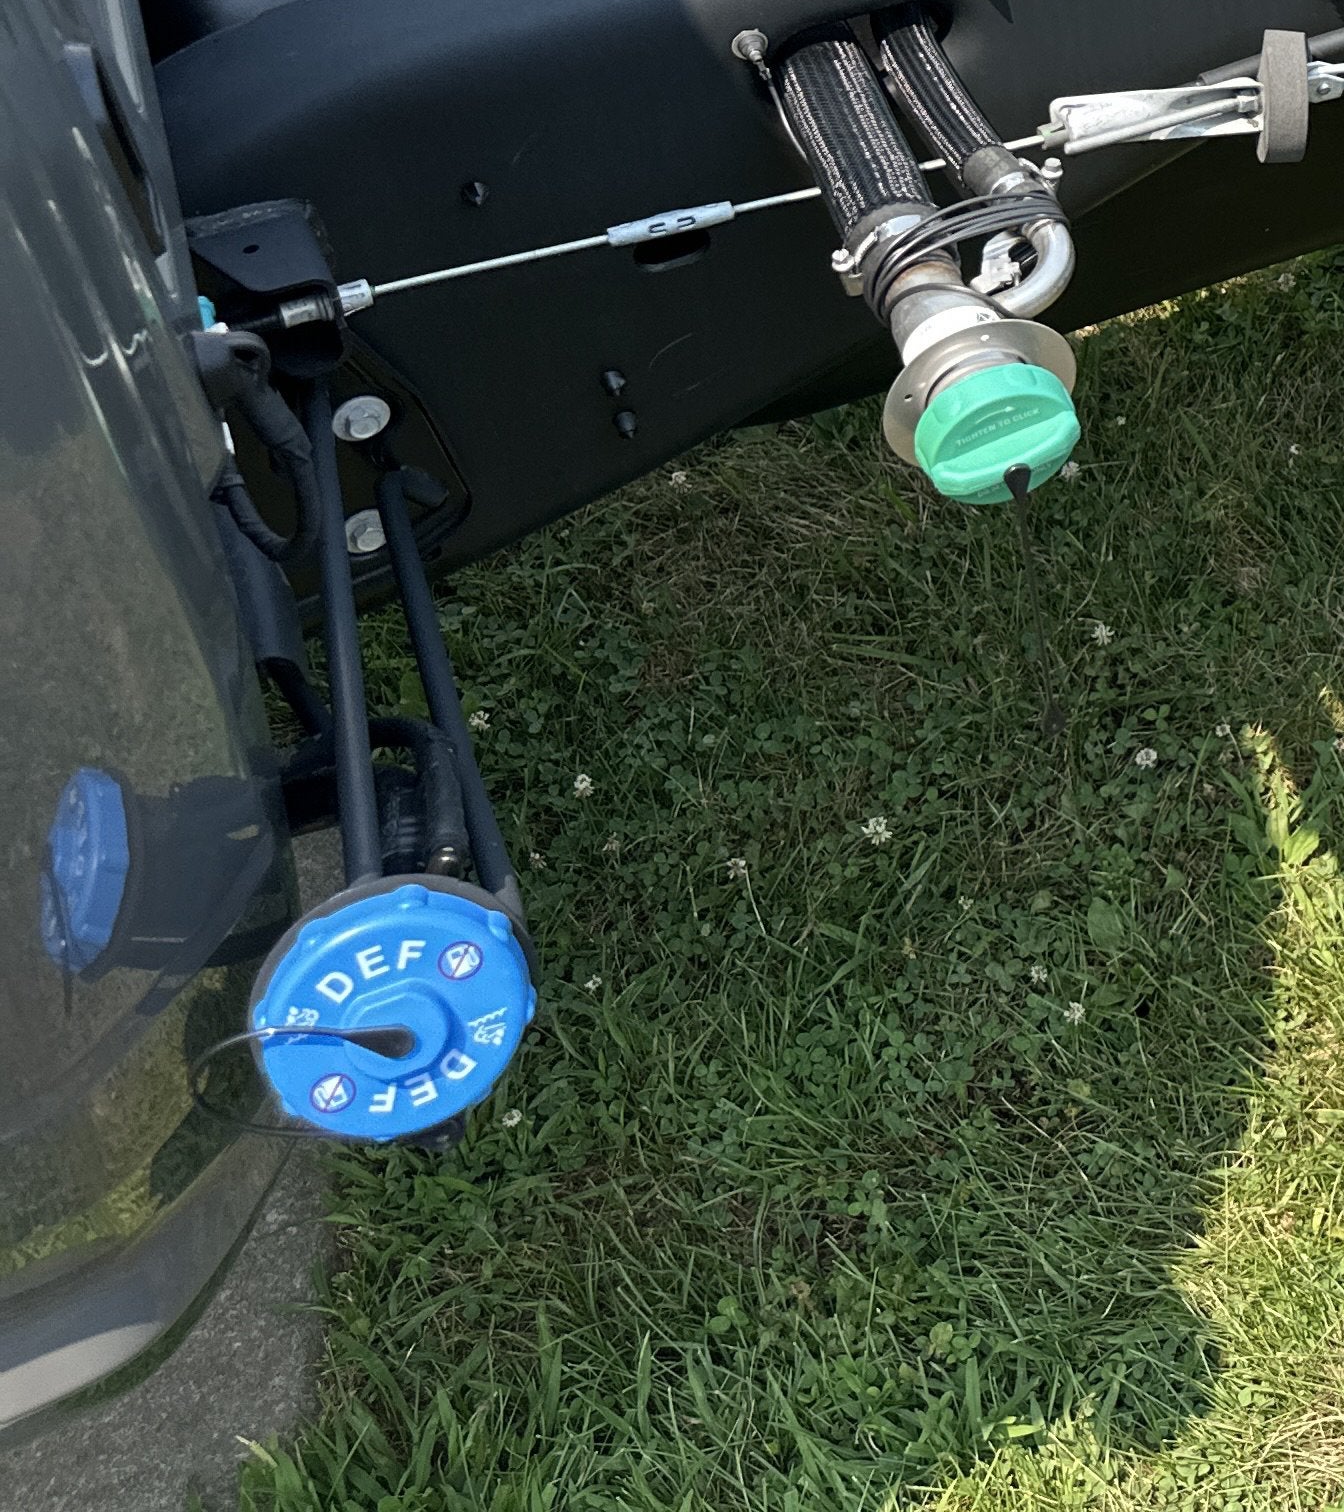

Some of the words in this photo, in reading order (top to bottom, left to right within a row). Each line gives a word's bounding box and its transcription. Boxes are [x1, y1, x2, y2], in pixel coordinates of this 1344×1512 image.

[955, 424, 997, 448] TIGHTEN
[999, 418, 1012, 428] TO
[1013, 408, 1041, 423] CLICK
[315, 939, 427, 1004] DEF
[368, 1048, 478, 1113] DEF
